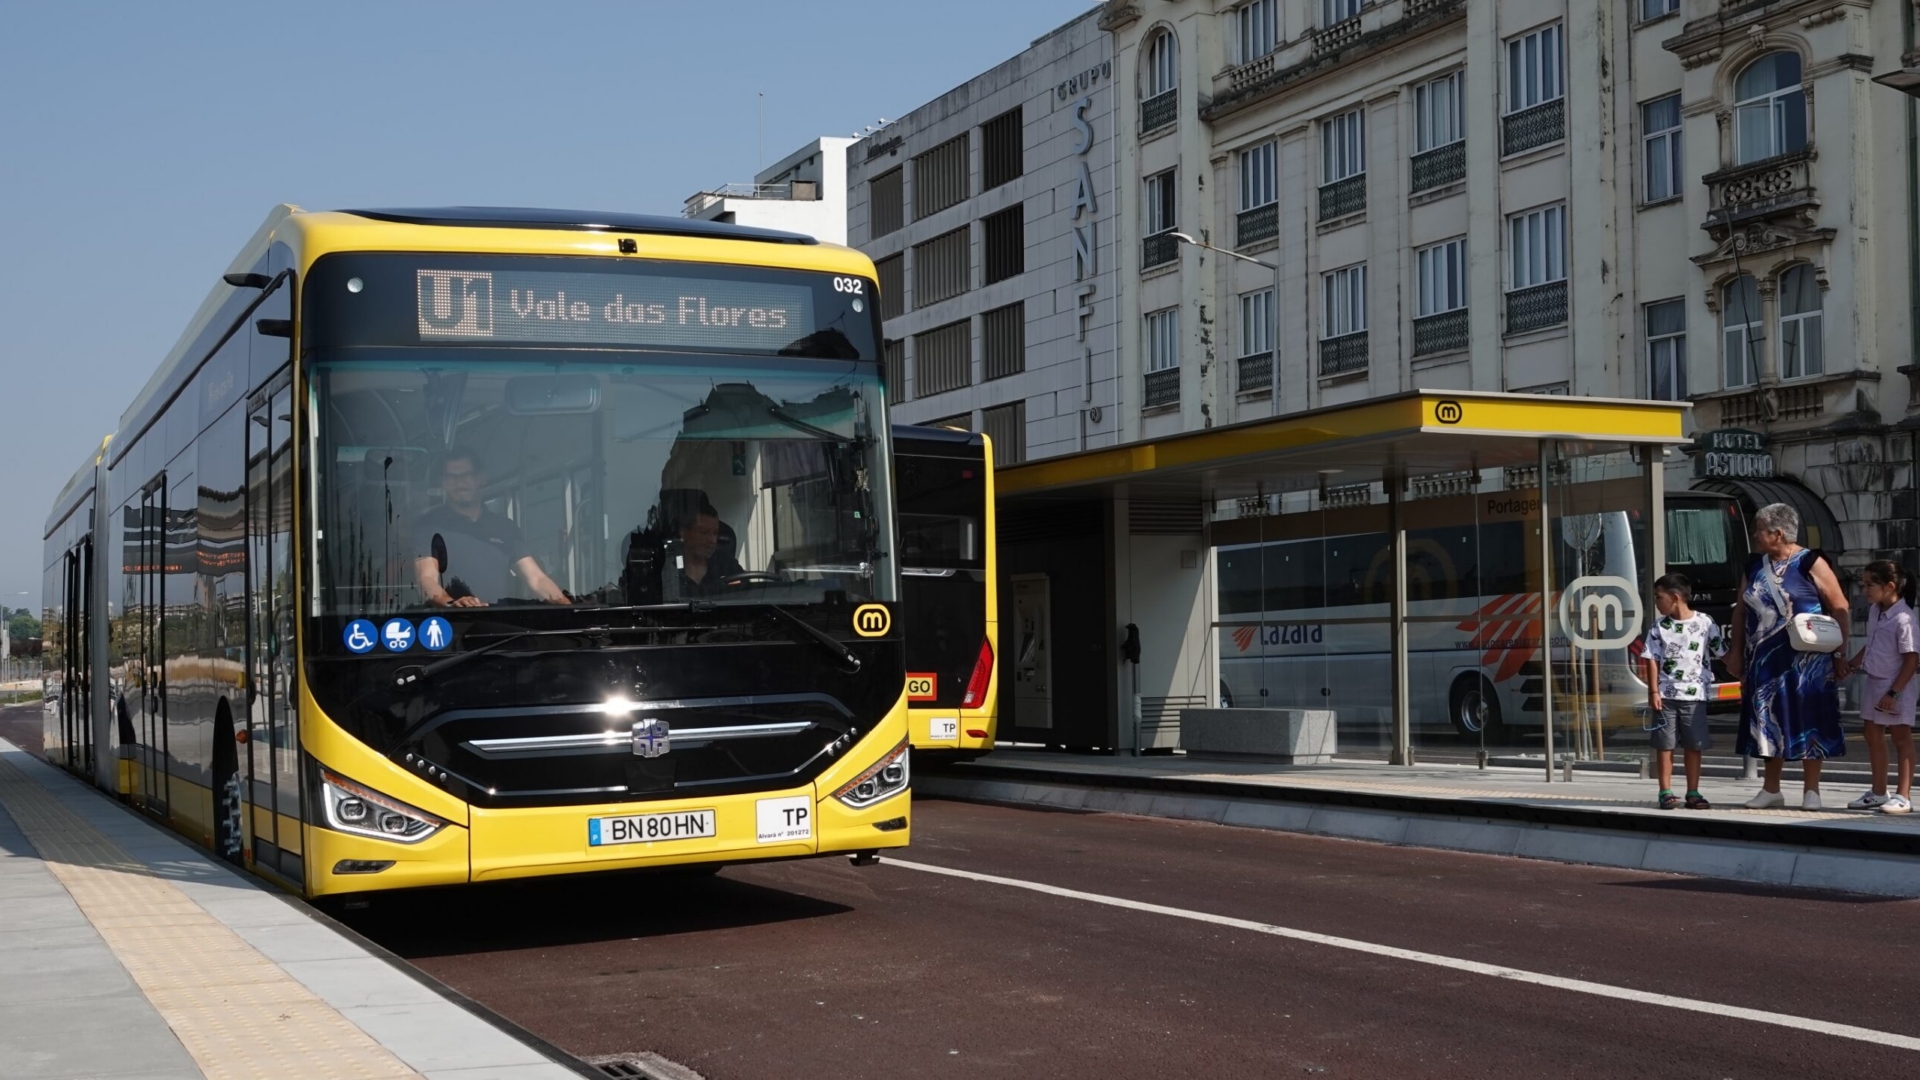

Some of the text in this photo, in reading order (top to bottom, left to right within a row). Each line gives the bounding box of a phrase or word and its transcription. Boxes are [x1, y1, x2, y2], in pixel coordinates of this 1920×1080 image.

[1057, 60, 1111, 100] GRUPO
[833, 277, 863, 295] 032
[419, 274, 786, 334] U1 Vale das Flores
[1713, 432, 1763, 450] HOTEL
[1705, 452, 1773, 478] ASTORIA
[943, 723, 956, 733] TP
[783, 808, 808, 827] TP
[758, 832, 777, 840] Alvará
[786, 828, 810, 838] 201272
